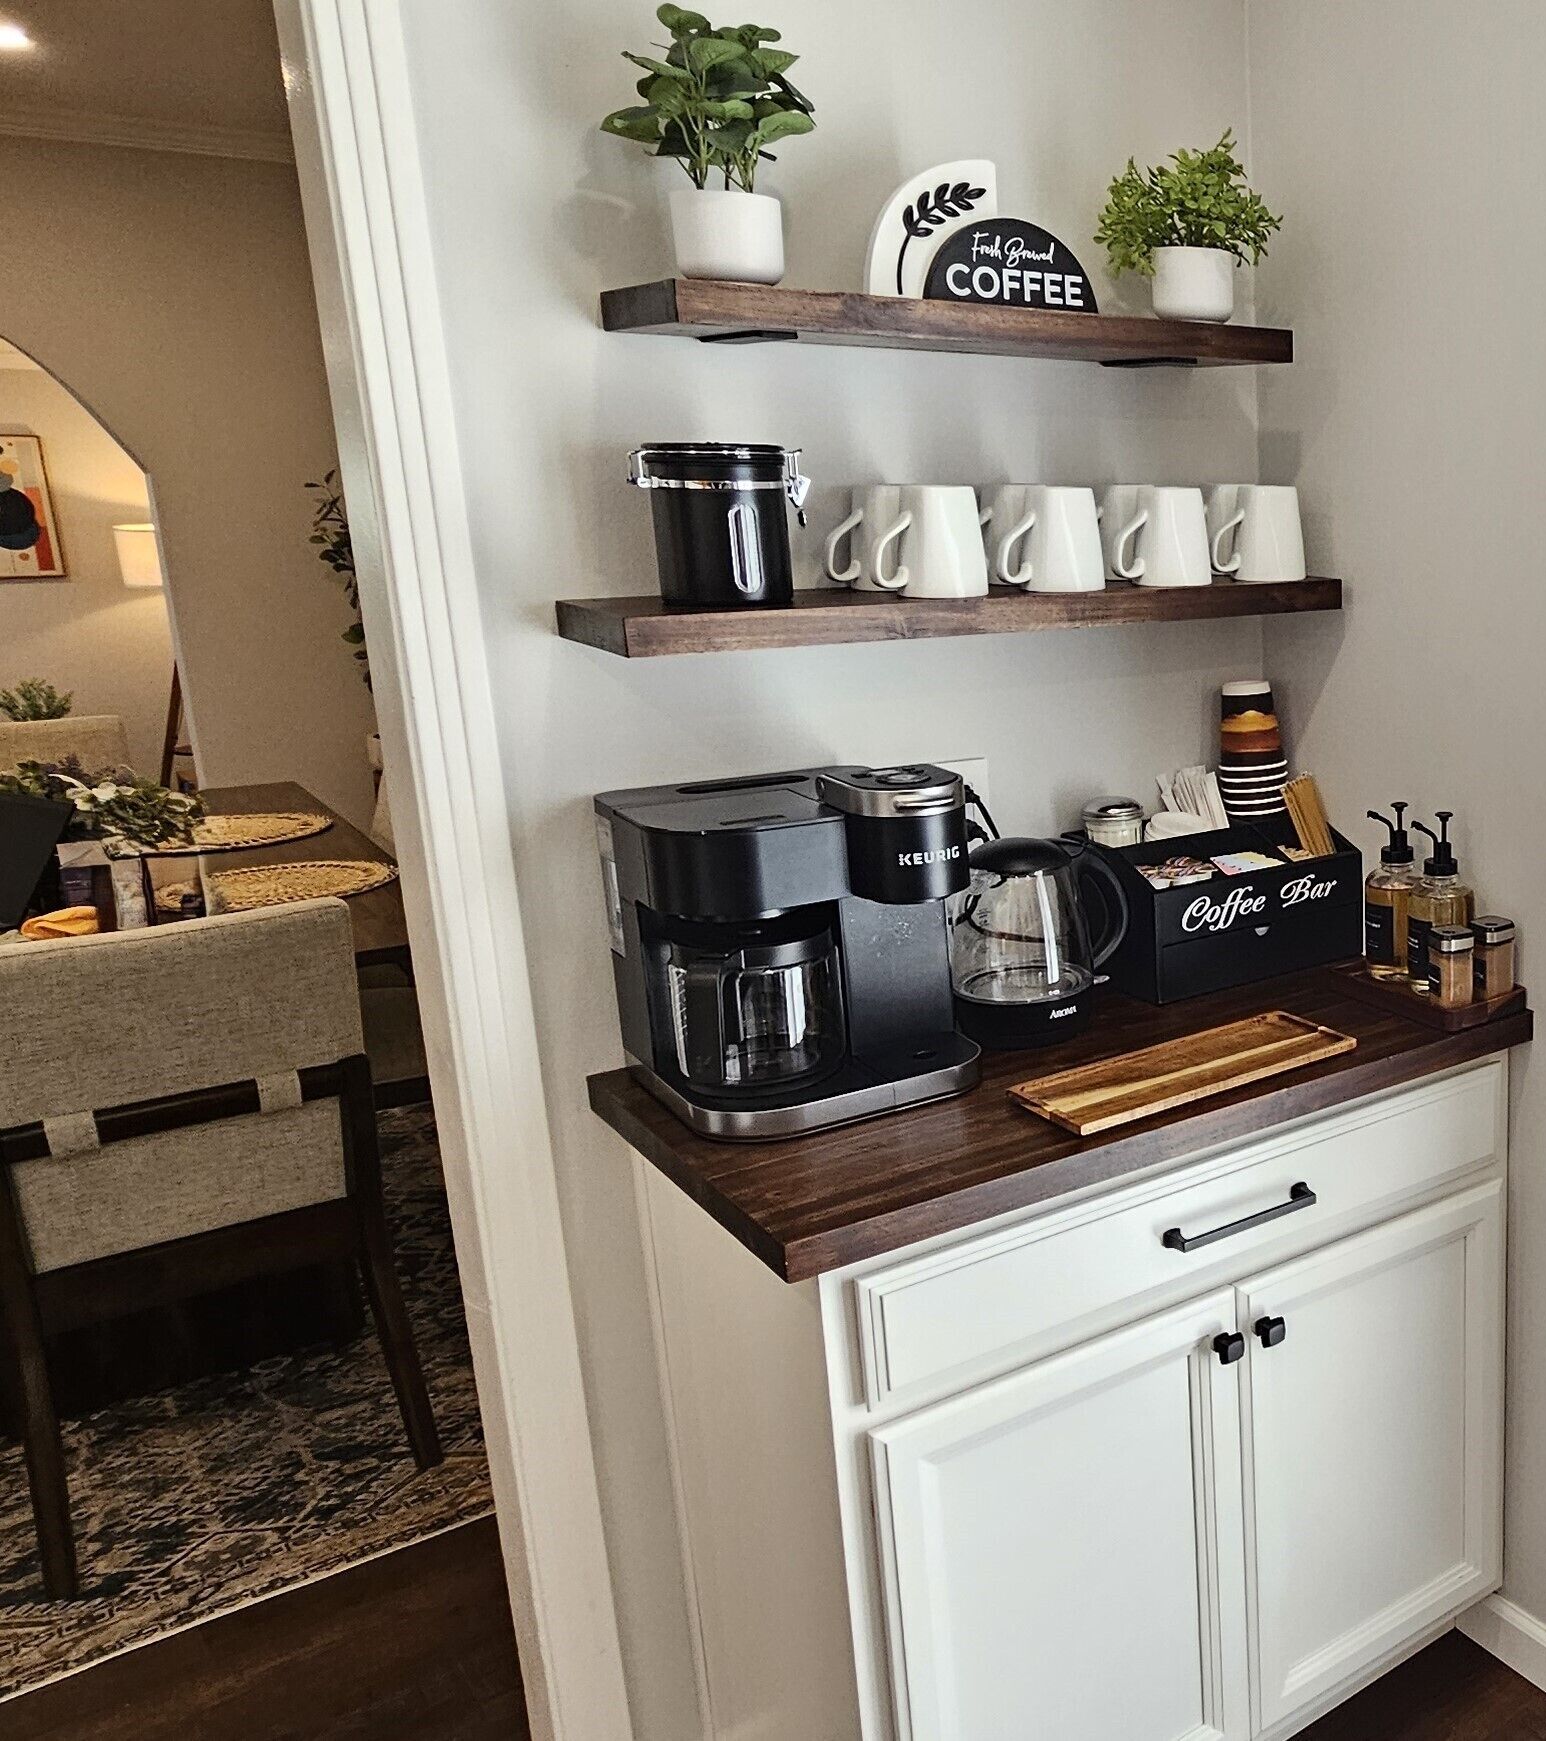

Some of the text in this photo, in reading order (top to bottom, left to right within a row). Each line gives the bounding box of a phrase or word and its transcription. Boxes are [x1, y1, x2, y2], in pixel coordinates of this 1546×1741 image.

[971, 231, 1055, 268] Fresh Brewed
[946, 263, 1084, 307] COFFEE
[898, 845, 960, 866] KEURIG
[1181, 873, 1338, 932] Coffee Bar
